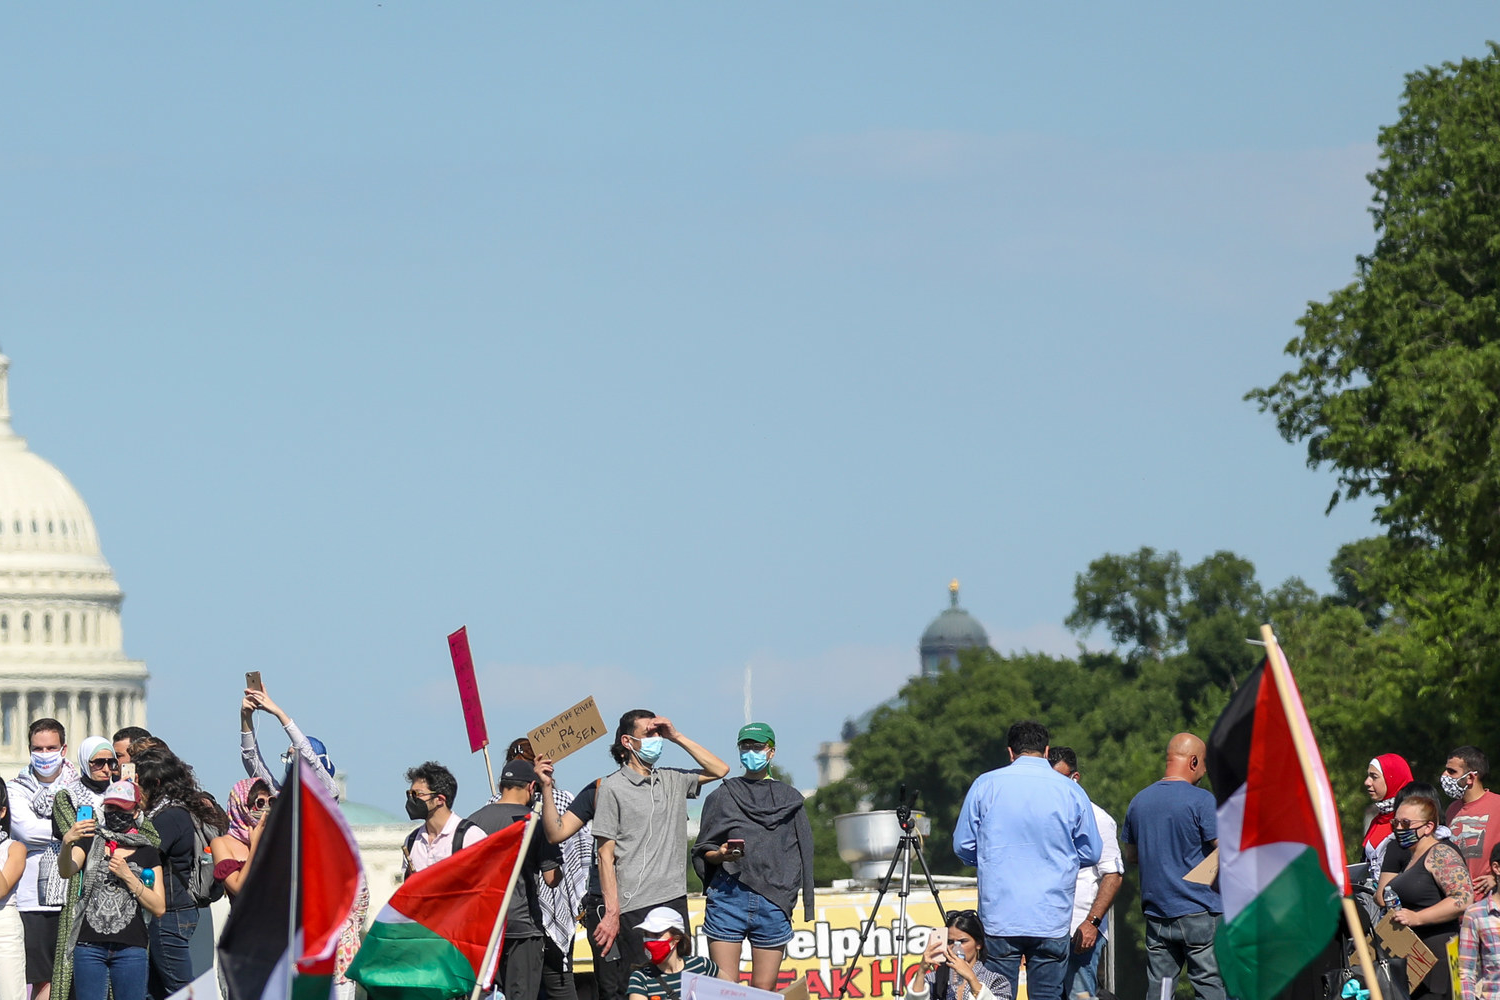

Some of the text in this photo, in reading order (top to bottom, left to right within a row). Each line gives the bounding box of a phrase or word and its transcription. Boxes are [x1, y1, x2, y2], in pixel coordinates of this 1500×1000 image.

[533, 699, 595, 743] FROM THE RIVER
[558, 724, 576, 742] P4
[544, 725, 598, 761] TO THE SEA
